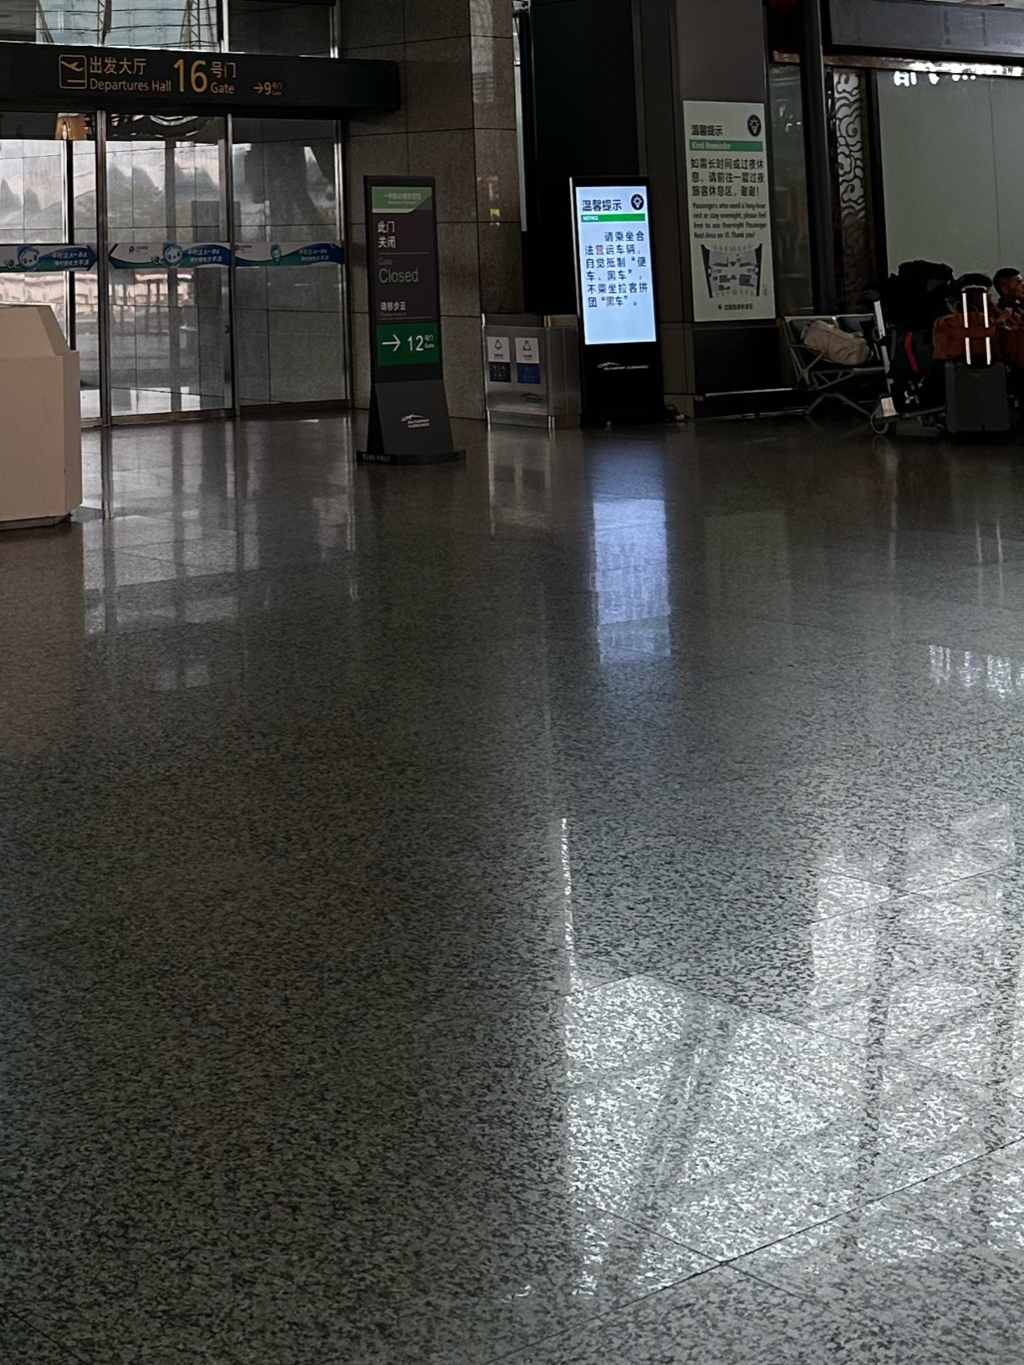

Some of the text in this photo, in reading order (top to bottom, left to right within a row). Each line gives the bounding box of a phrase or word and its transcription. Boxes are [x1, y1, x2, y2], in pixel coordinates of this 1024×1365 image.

[90, 57, 146, 75] 出发大厅
[211, 62, 236, 78] 号门
[173, 59, 208, 92] 16
[90, 78, 172, 92] Departures Hall
[211, 82, 235, 95] Gate
[264, 81, 272, 96] 9
[691, 125, 723, 136] 温馨提示
[691, 158, 764, 169] 如需长时间或过夜休
[582, 199, 622, 211] 温馨提示
[377, 221, 395, 234] 此门
[378, 236, 396, 248] 关闭
[604, 231, 644, 242] 请乘坐合
[378, 268, 419, 283] Closed
[587, 282, 647, 294] 不乘坐拉客拼
[407, 335, 424, 351] 12
